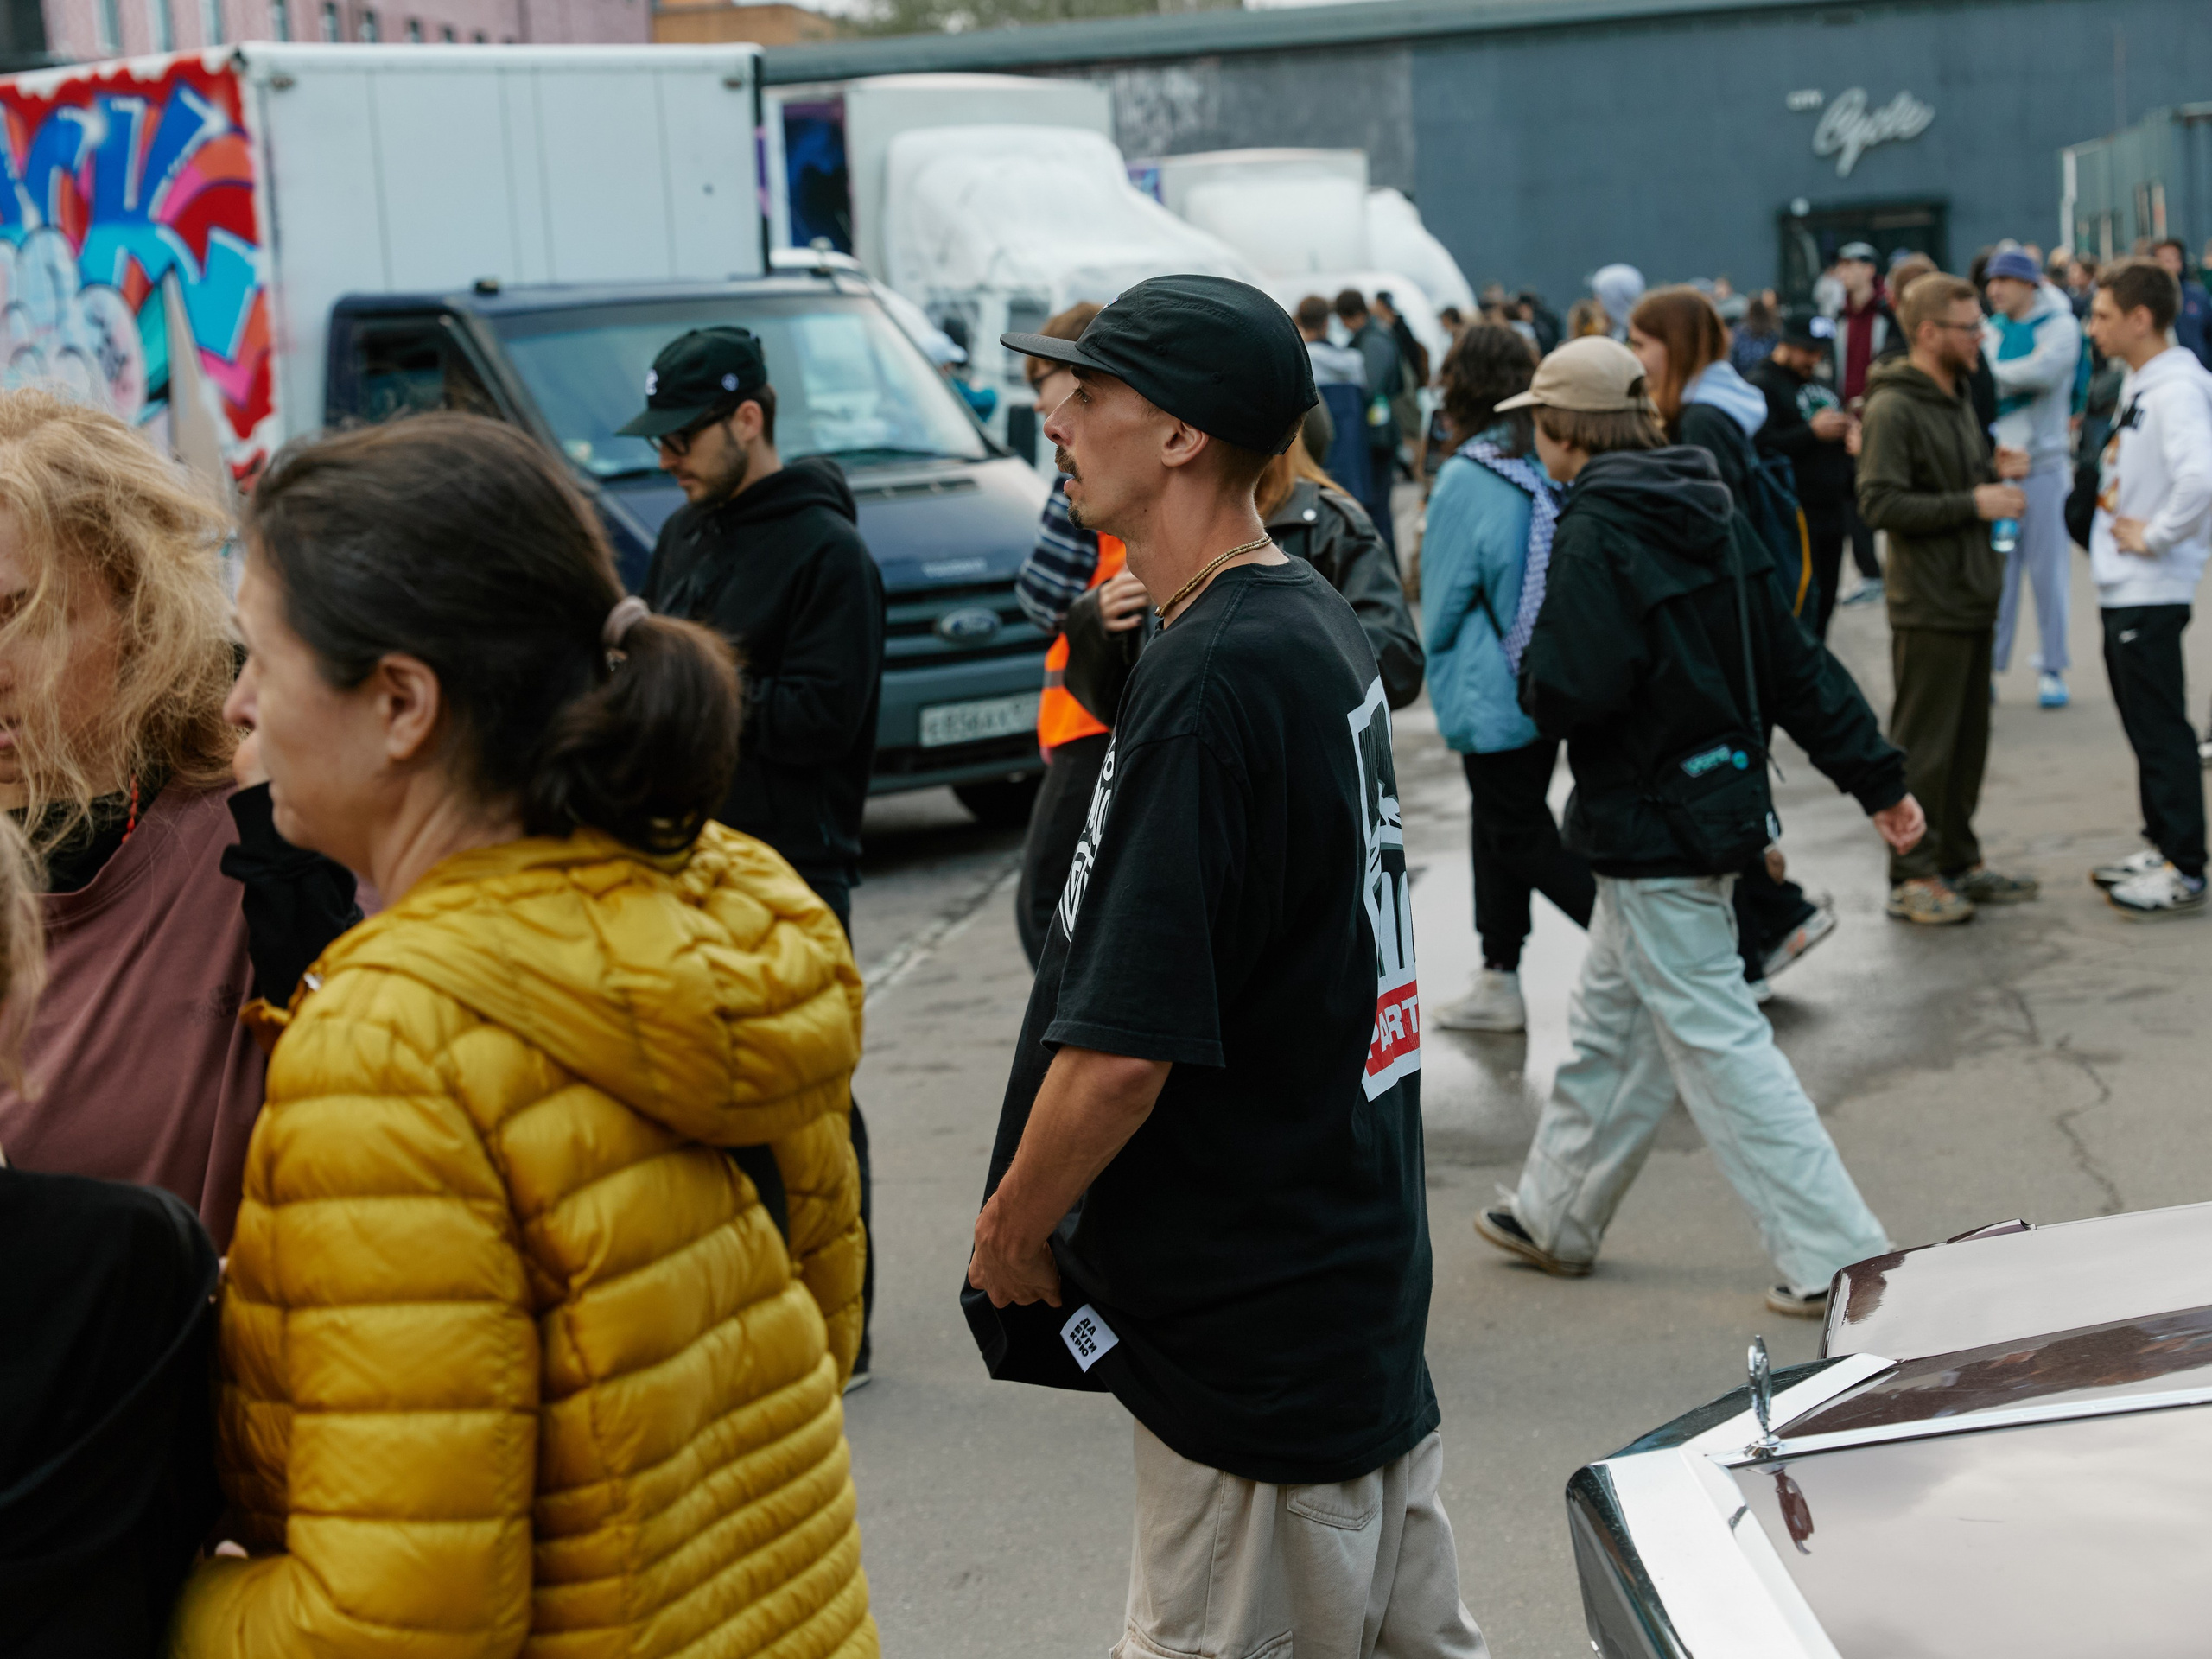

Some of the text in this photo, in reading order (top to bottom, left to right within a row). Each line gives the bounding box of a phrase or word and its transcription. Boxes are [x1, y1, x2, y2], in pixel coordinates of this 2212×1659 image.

[1074, 1325, 1097, 1354] БУГИ
[1079, 1317, 1097, 1337] ДА
[1069, 1332, 1089, 1357] КРЮ
